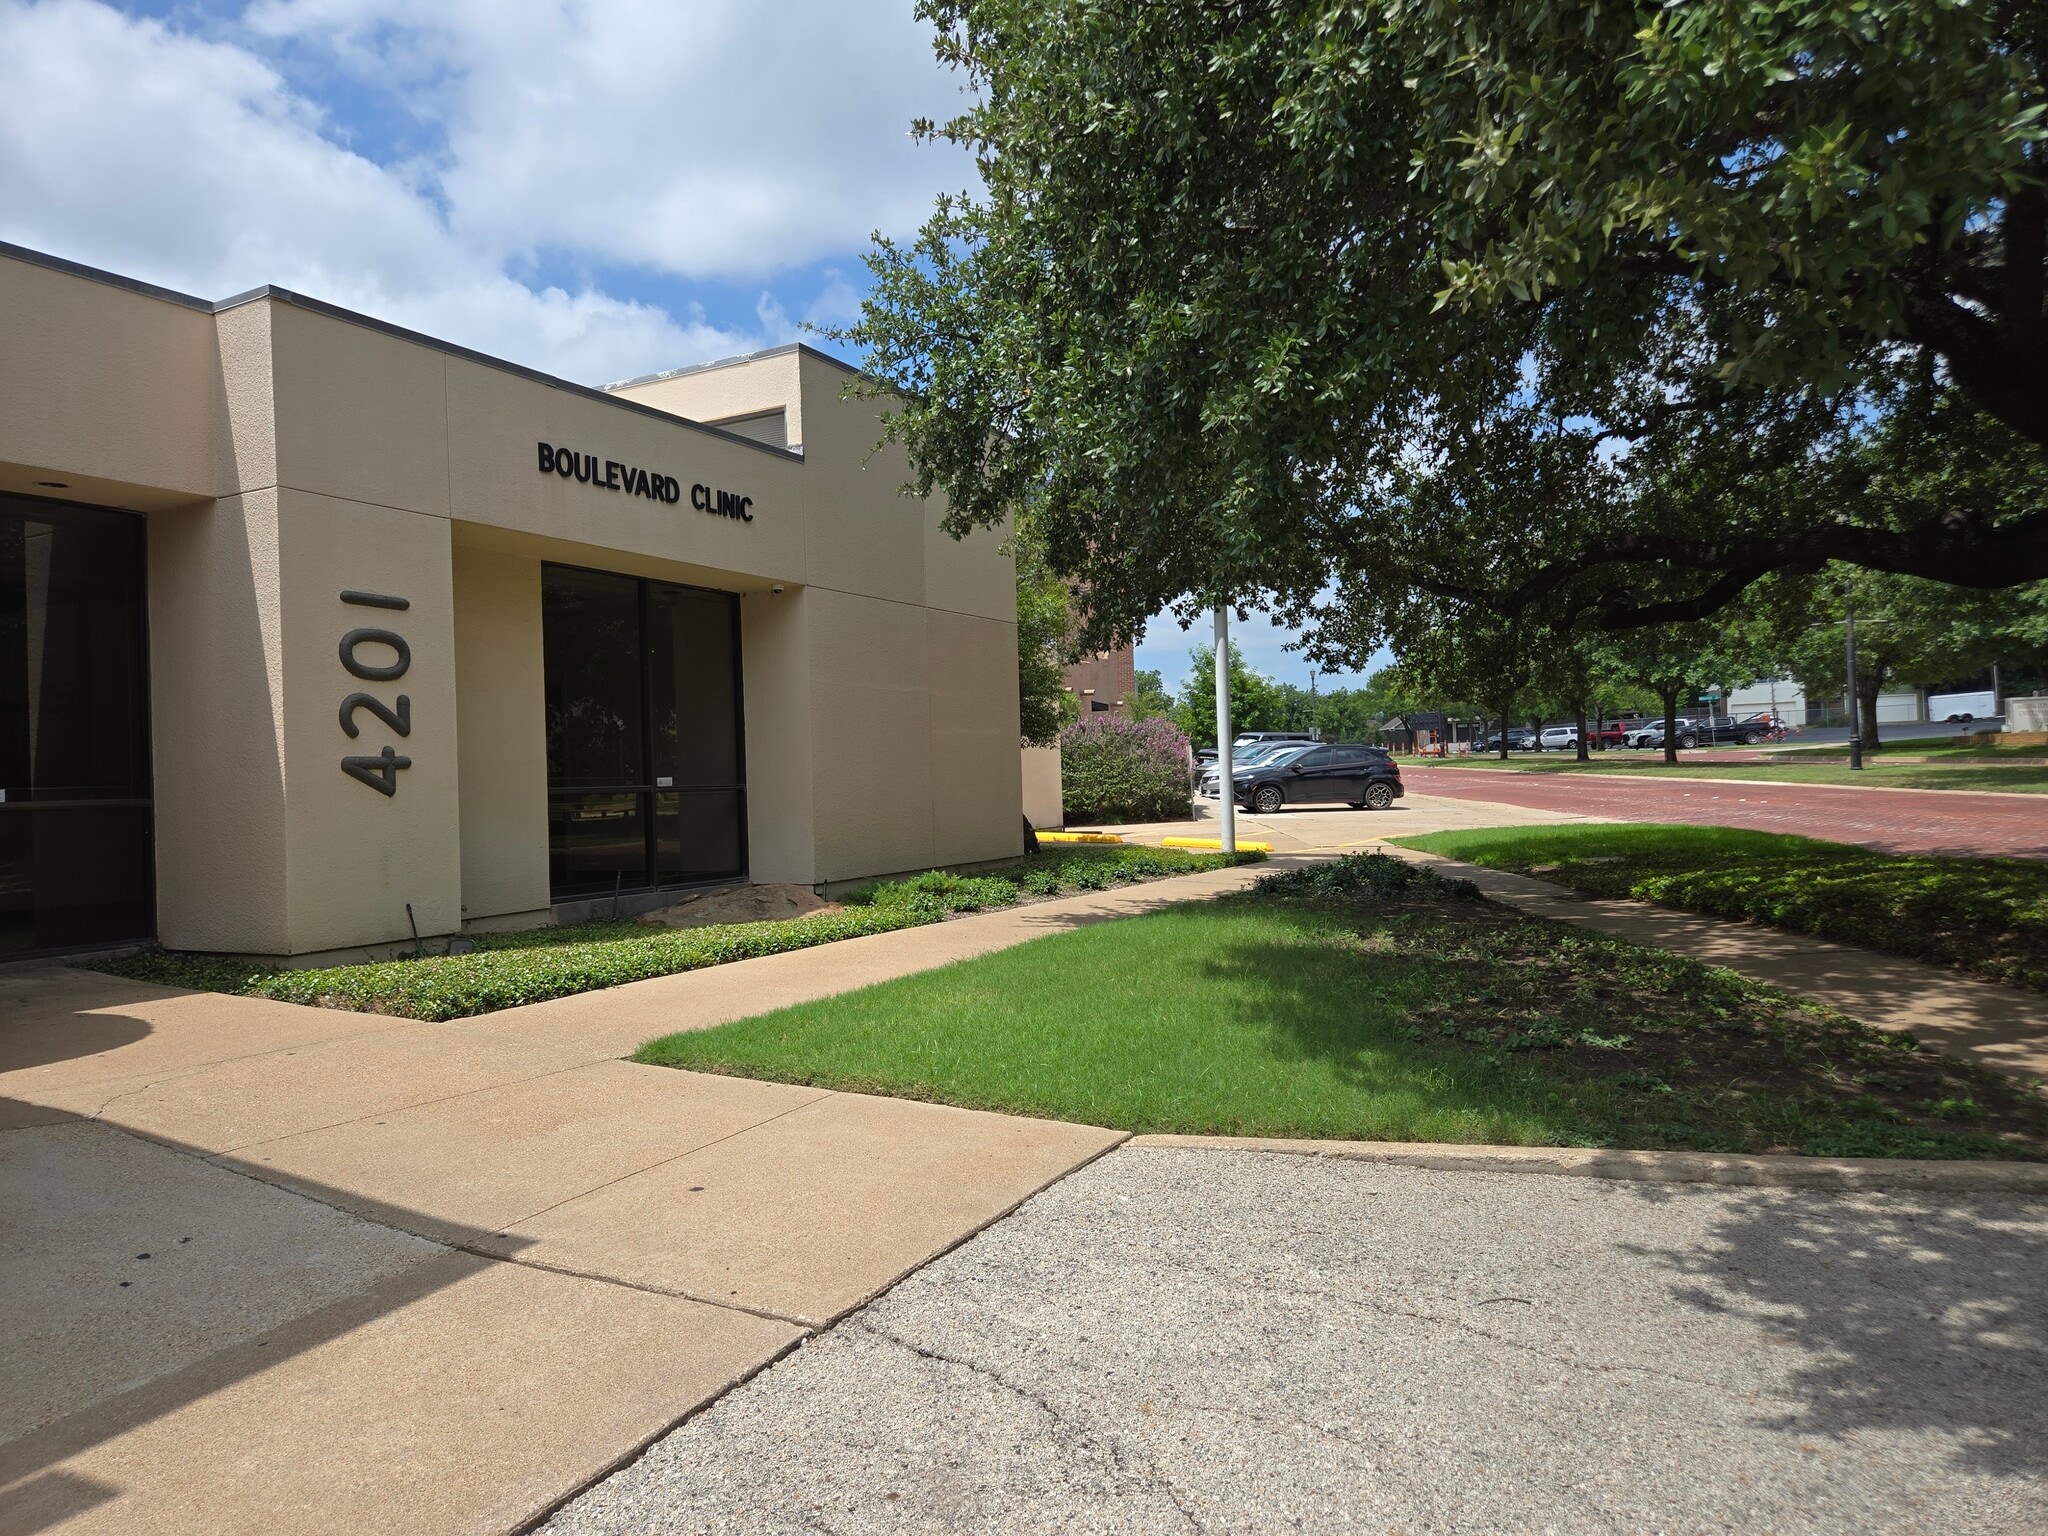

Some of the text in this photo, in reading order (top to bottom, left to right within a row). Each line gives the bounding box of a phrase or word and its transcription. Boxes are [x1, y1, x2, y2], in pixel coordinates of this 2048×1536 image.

[538, 442, 754, 522] BOULEVARD CLINIC
[339, 590, 412, 797] 4201
